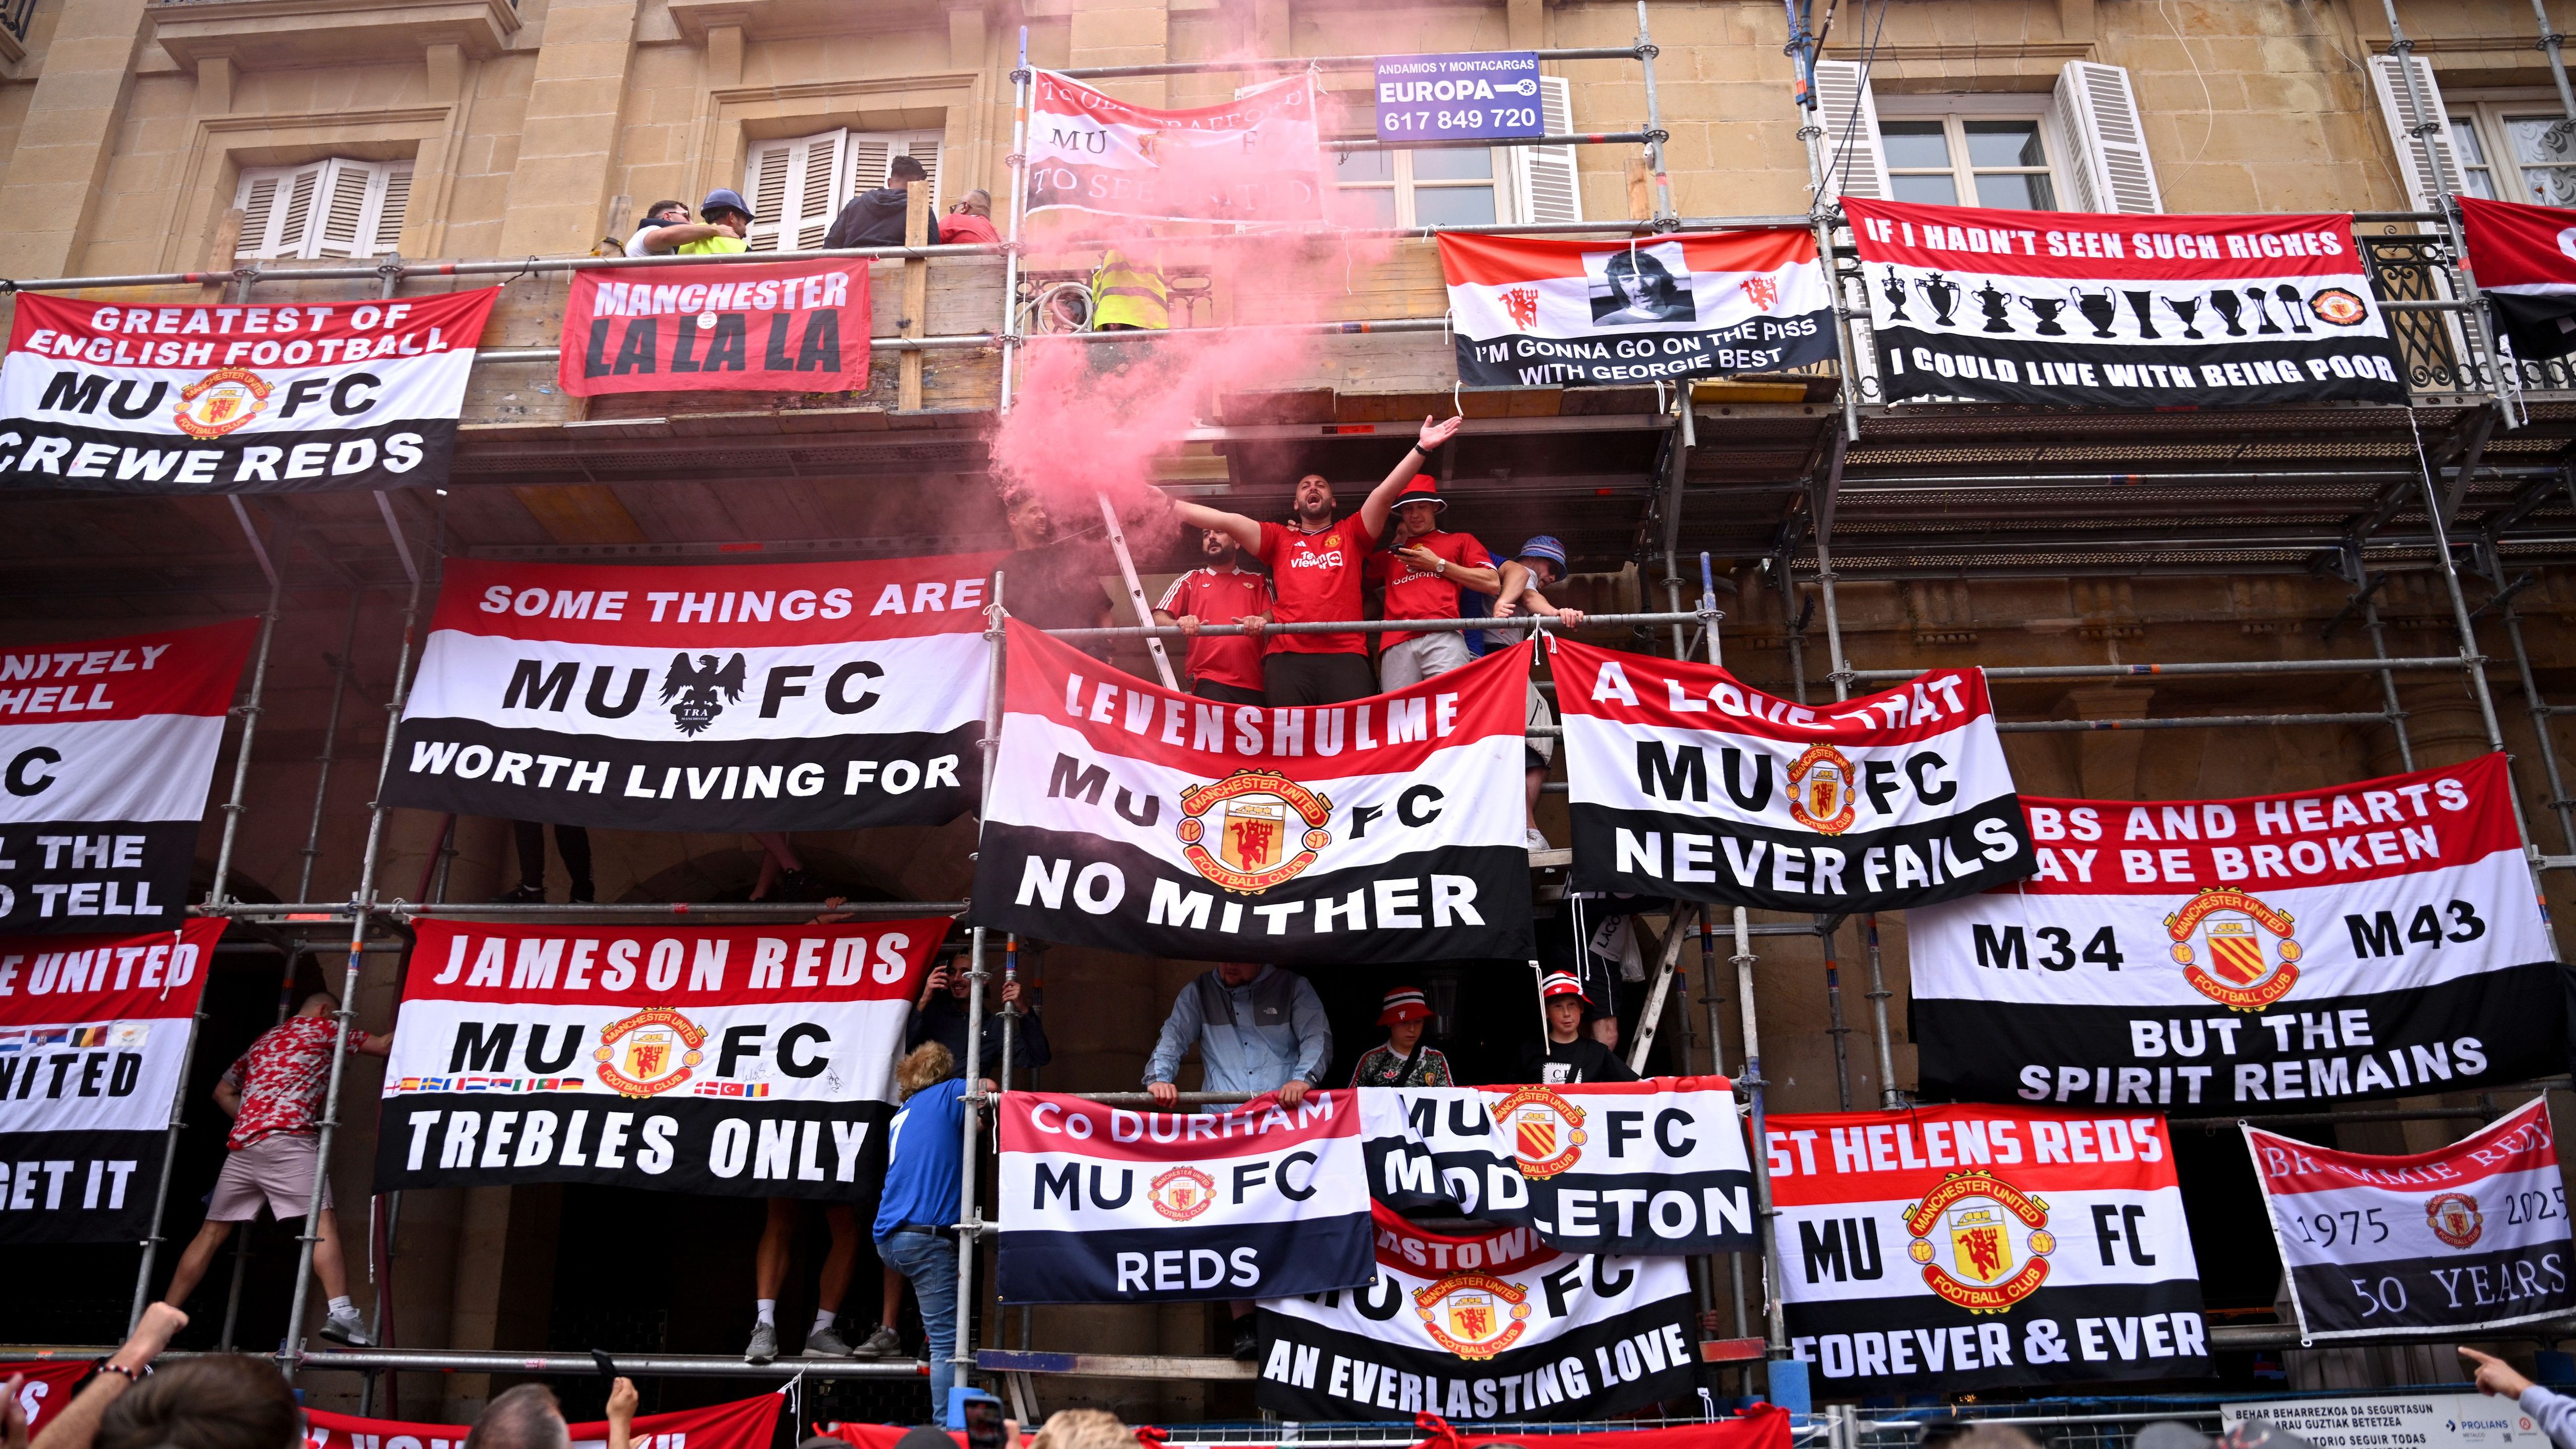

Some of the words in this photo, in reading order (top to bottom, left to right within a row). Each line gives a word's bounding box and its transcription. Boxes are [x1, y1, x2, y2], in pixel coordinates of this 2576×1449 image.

[1378, 63, 1436, 75] ANDAMIOS
[1439, 62, 1448, 73] Y
[1449, 60, 1534, 72] MONTACARGAS
[1379, 80, 1494, 103] EUROPA
[1049, 128, 1107, 153] MU
[1385, 112, 1430, 130] 617
[1437, 110, 1482, 129] 849
[1490, 108, 1535, 127] 720
[1034, 168, 1078, 194] TO
[1088, 174, 1155, 203] SEE
[1865, 218, 1892, 243] IF
[1901, 222, 1913, 246] I
[1923, 225, 2035, 255] HADN'T
[2046, 231, 2125, 258] SEEN
[2133, 233, 2218, 259] SUCH
[2225, 232, 2343, 258] RICHES
[593, 272, 849, 317] MANCHESTER
[91, 306, 334, 335] GREATEST
[350, 304, 411, 331] OF
[1517, 340, 1608, 360] GONNA
[1616, 339, 1655, 358] GO
[1663, 336, 1701, 354] ON
[1707, 322, 1757, 346] THE
[1764, 318, 1817, 342] PISS
[25, 329, 211, 366] ENGLISH
[224, 327, 447, 366] FOOTBALL
[584, 318, 657, 378] LA
[671, 313, 746, 373] LA
[764, 309, 841, 373] LA
[1518, 363, 1594, 386] WITH
[1593, 355, 1711, 380] GEORGIE
[1720, 348, 1782, 369] BEST
[1890, 348, 1903, 375] I
[1912, 347, 2018, 383] COULD
[2026, 362, 2098, 387] LIVE
[2102, 364, 2195, 388] WITH
[2200, 360, 2301, 387] BEING
[2309, 356, 2398, 382] POOR
[38, 371, 166, 420] MU
[279, 372, 382, 418] FC
[0, 432, 224, 483] CREWE
[233, 432, 424, 484] REDS
[480, 584, 628, 621] SOME
[645, 586, 854, 624] THINGS
[870, 577, 986, 617] ARE
[503, 658, 650, 718] MU
[758, 661, 885, 718] FC
[1591, 662, 1640, 706] A
[1831, 674, 1965, 730] THAT
[1065, 672, 1460, 757] LEVENSHULME
[409, 740, 610, 794] WORTH
[623, 765, 827, 800] LIVING
[843, 753, 961, 796] FOR
[1636, 740, 1772, 812] MU
[1865, 751, 1958, 815] FC
[1792, 749, 1833, 779] MANCHESTER
[1834, 755, 1851, 781] UNITED
[1047, 752, 1160, 827] MU
[1350, 784, 1444, 839] FC
[1189, 778, 1278, 812] MANCHESTER
[1280, 783, 1320, 820] UNITED
[2124, 805, 2236, 842] AND
[2254, 777, 2469, 837] HEARTS
[1795, 810, 1836, 830] FOOTBALL
[1836, 812, 1851, 828] CLUB
[36, 835, 146, 869] THE
[1193, 856, 1263, 887] FOOTBALL
[1268, 860, 1306, 882] CLUB
[1616, 828, 1847, 895] NEVER
[1863, 818, 2019, 893] FAILS
[2122, 847, 2196, 884] BE
[2216, 825, 2441, 882] BROKEN
[32, 882, 163, 917] TELL
[1014, 854, 1126, 915] NO
[1146, 874, 1486, 936] MITHER
[2174, 895, 2241, 937] MANCHESTER
[2244, 900, 2286, 932] UNITED
[1972, 923, 2124, 972] M34
[2344, 899, 2486, 960] M43
[27, 944, 200, 996] UNITED
[433, 935, 730, 992] JAMESON
[747, 932, 909, 989] REDS
[2194, 975, 2260, 1003] FOOTBALL
[2263, 973, 2291, 998] CLUB
[447, 1021, 585, 1075] MU
[715, 1022, 831, 1078] FC
[606, 1013, 672, 1042] MANCHESTER
[672, 1016, 698, 1044] UNITED
[2130, 1017, 2242, 1058] BUT
[2261, 1009, 2374, 1053] THE
[603, 1069, 650, 1092] FOOTBALL
[654, 1074, 683, 1091] CLUB
[2017, 1064, 2213, 1105] SPIRIT
[2233, 1036, 2488, 1102] REMAINS
[1031, 1102, 1093, 1140] Co
[1111, 1091, 1334, 1143] DURHAM
[1607, 1107, 1697, 1158] FC
[406, 1110, 679, 1175] TREBLES
[708, 1118, 869, 1183] ONLY
[1766, 1130, 1818, 1175] ST
[1830, 1119, 2022, 1173] HELENS
[2028, 1117, 2162, 1164] REDS
[83, 1160, 137, 1209] IT
[1033, 1162, 1134, 1211] MU
[1232, 1151, 1318, 1204] FC
[1156, 1170, 1193, 1187] MANCHESTER
[1193, 1172, 1210, 1185] UNITED
[1156, 1204, 1190, 1217] FOOTBALL
[1191, 1202, 1207, 1215] CLUB
[1913, 1180, 1991, 1232] MANCHESTER
[1993, 1184, 2039, 1222] UNITED
[2297, 1207, 2390, 1248] 1975
[1798, 1217, 1884, 1284] MU
[2090, 1204, 2156, 1267] FC
[1117, 1247, 1260, 1291] REDS
[1420, 1277, 1483, 1306] MANCHESTER
[1486, 1280, 1519, 1300] UNITED
[1542, 1254, 1633, 1318] FC
[1933, 1275, 2006, 1304] FOOTBALL
[2007, 1267, 2040, 1297] CLUB
[2351, 1276, 2408, 1318] 50
[2430, 1253, 2566, 1308] YEARS
[1433, 1330, 1489, 1353] FOOTBALL
[1492, 1329, 1518, 1350] CLUB
[1792, 1322, 2014, 1378] FOREVER
[2023, 1319, 2070, 1365] &
[2076, 1311, 2207, 1360] EVER
[1263, 1339, 1320, 1390] AN
[1328, 1355, 1590, 1419] EVERLASTING
[1595, 1322, 1692, 1388] LOVE
[2236, 1409, 2270, 1420] BEHAR
[2274, 1407, 2348, 1418] BEHARREZKOA
[2351, 1406, 2364, 1415] DA
[2367, 1404, 2433, 1415] SEGURTASUN
[2305, 1418, 2349, 1428] GUZTIAK
[2352, 1417, 2402, 1427] BETETZEA
[2462, 1420, 2508, 1429] PROLIANS
[2350, 1435, 2388, 1445] SEGUIR
[2392, 1433, 2426, 1444] TODAS
